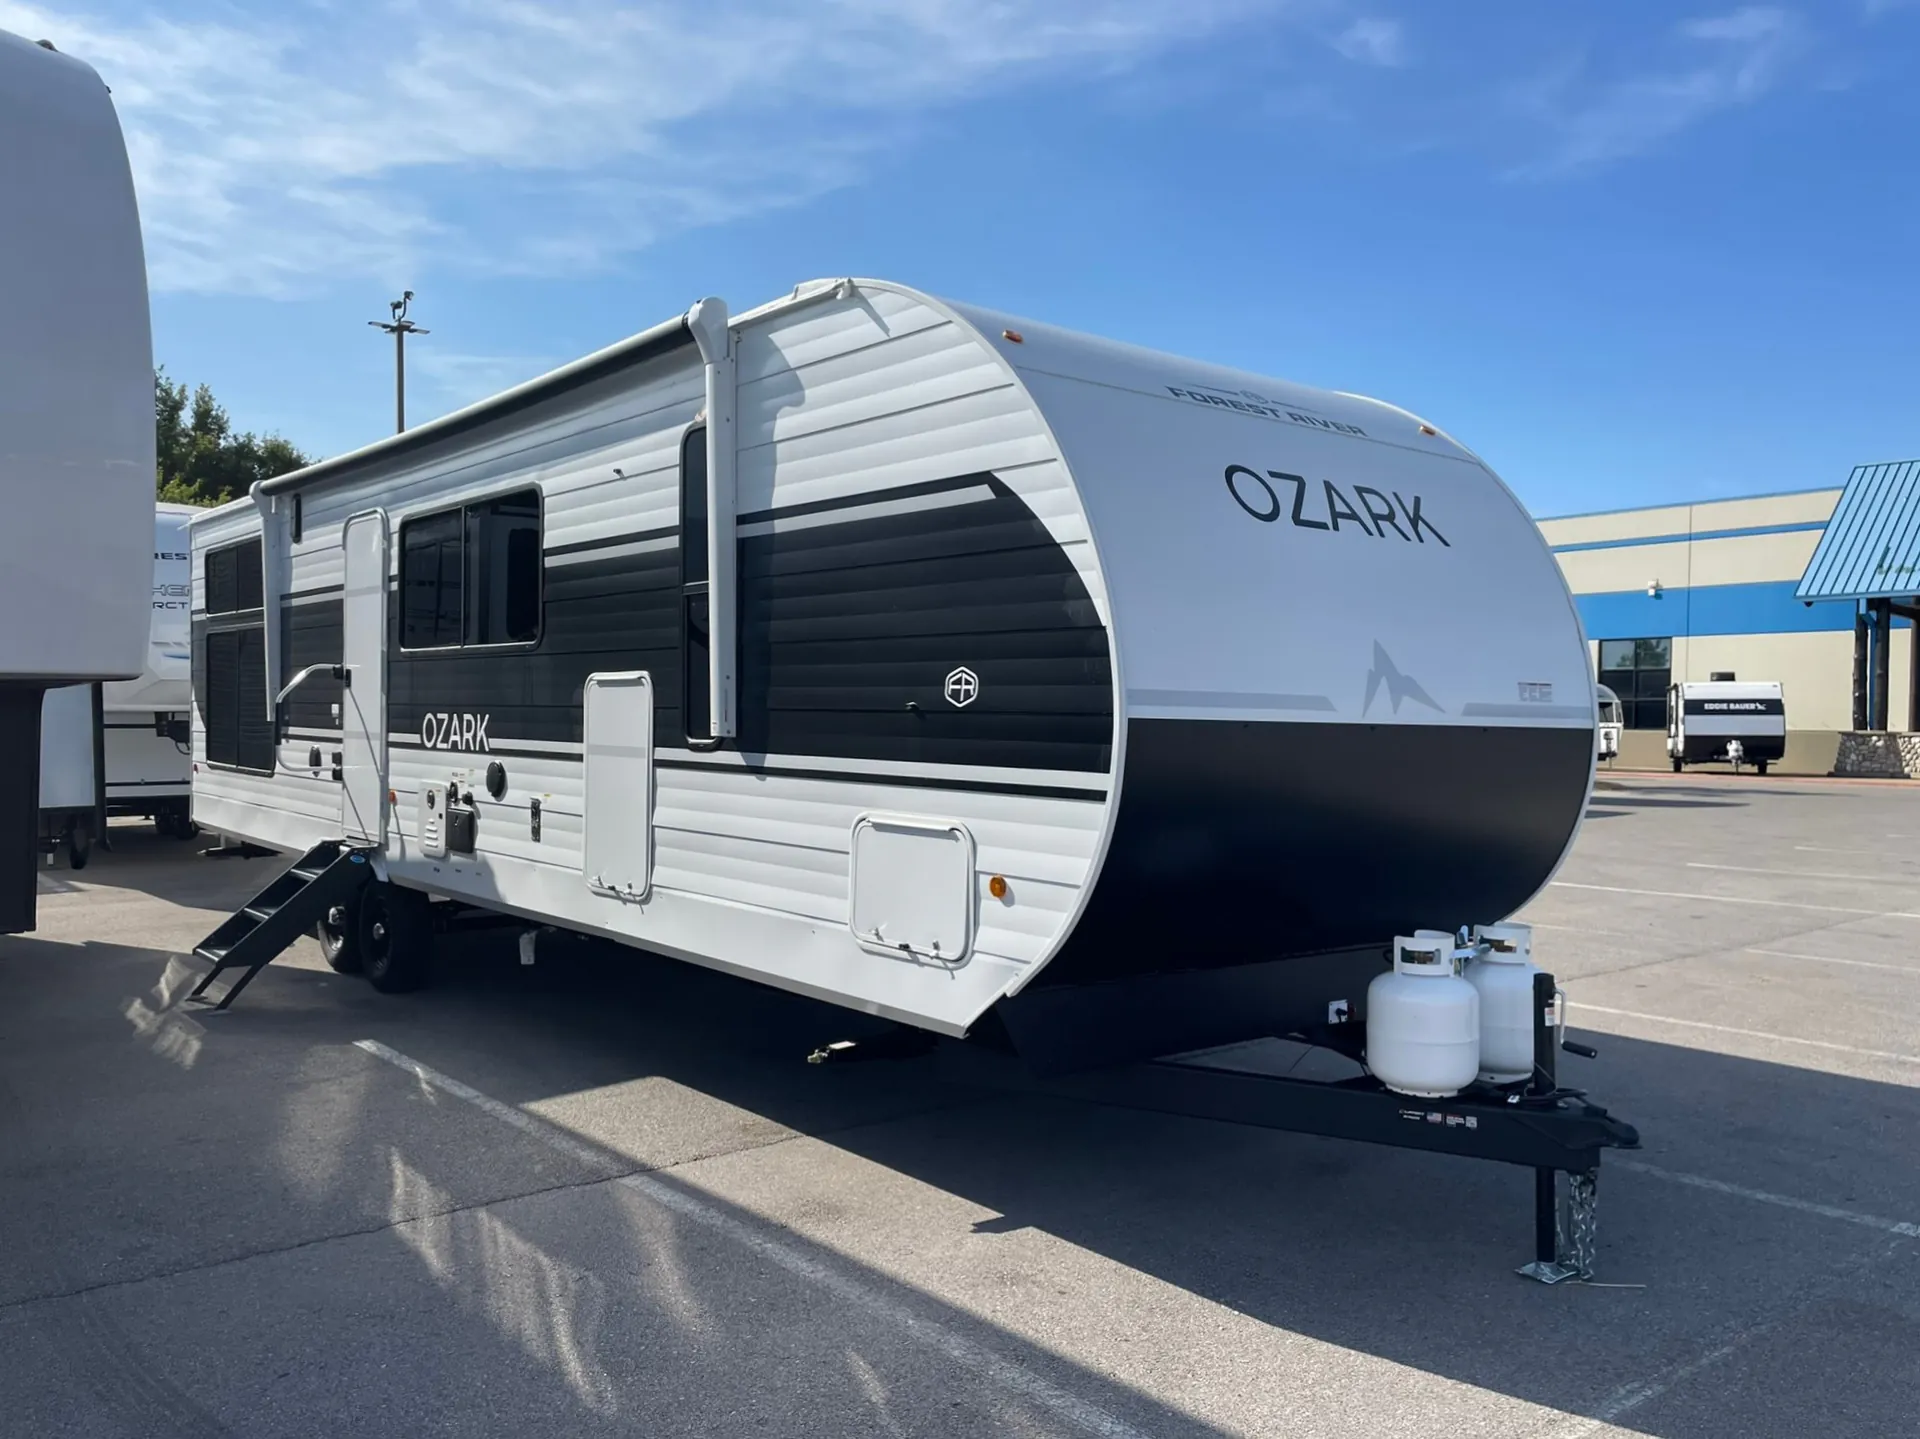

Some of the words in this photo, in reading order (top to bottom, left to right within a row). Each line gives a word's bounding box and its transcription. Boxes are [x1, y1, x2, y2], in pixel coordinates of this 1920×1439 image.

[1164, 385, 1281, 419] FOREST
[1286, 411, 1369, 437] RIVER
[1224, 464, 1451, 547] OZARK
[1703, 702, 1729, 710] EDDIE
[1729, 702, 1756, 710] BAUER
[422, 712, 490, 752] OZARK
